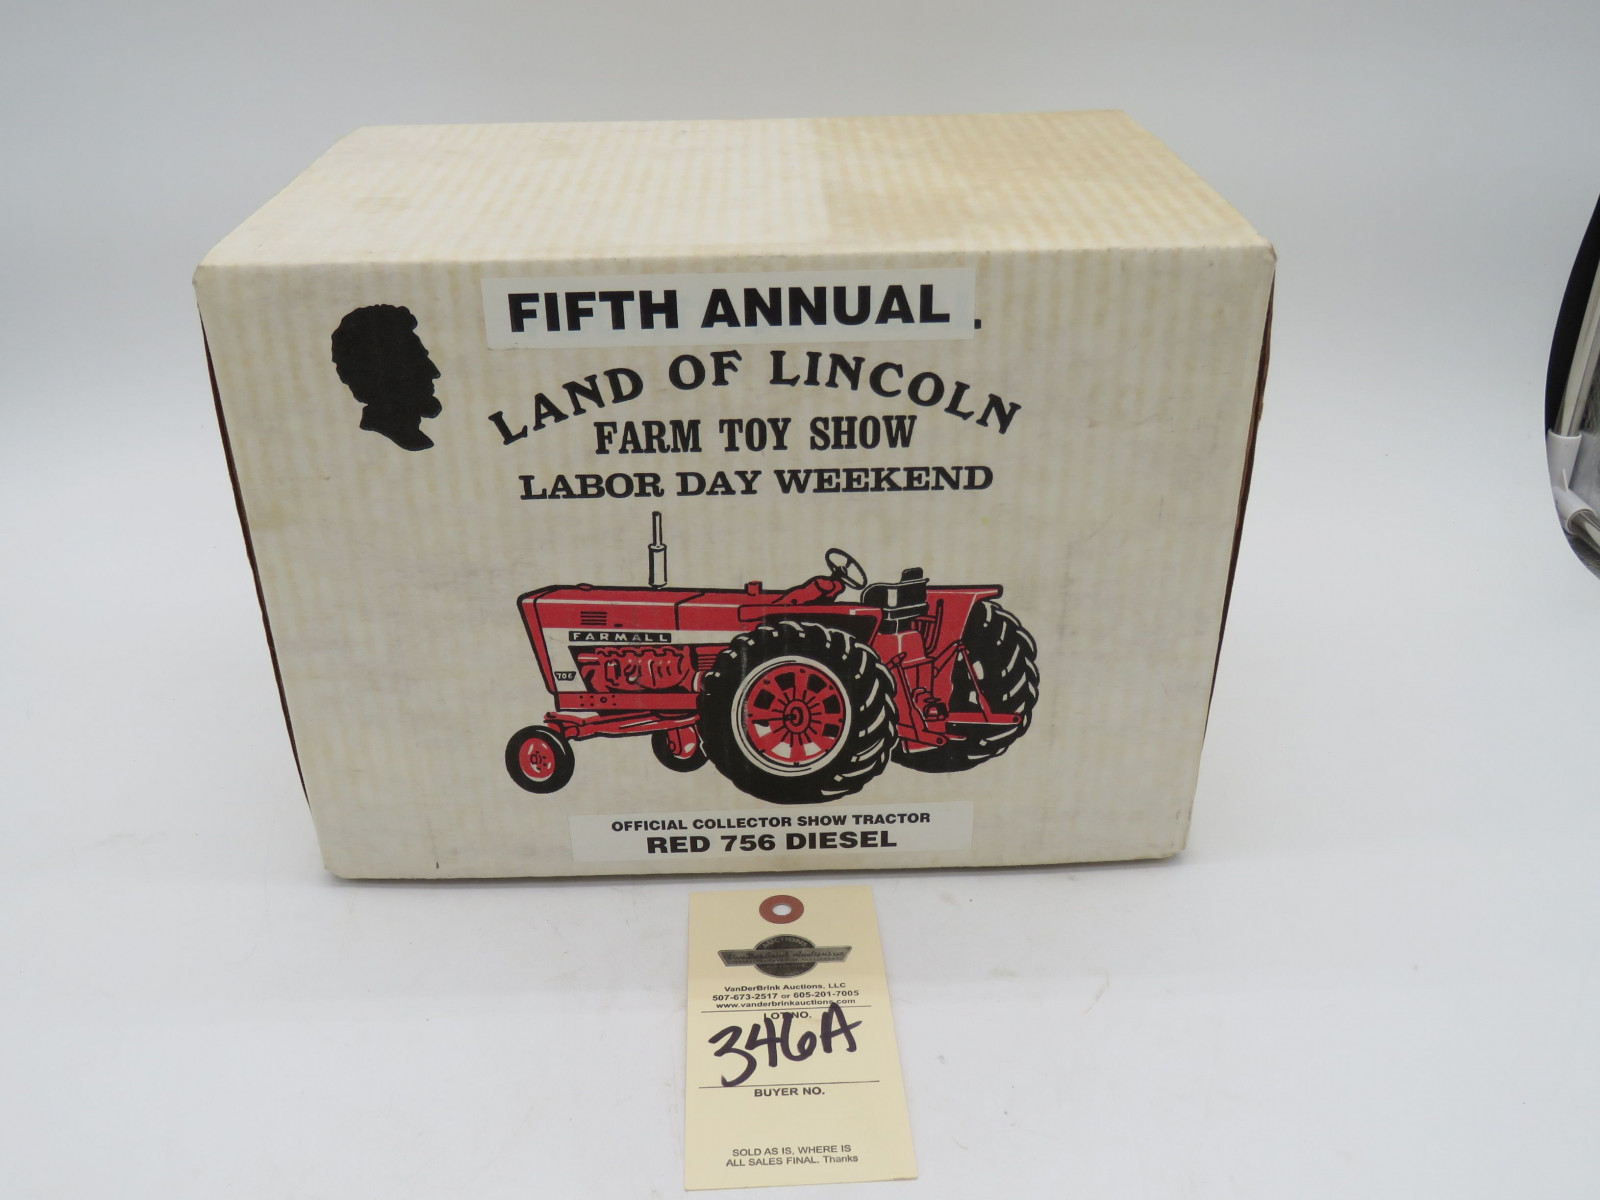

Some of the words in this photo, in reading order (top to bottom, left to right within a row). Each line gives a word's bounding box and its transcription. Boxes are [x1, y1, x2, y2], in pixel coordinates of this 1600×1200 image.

[508, 290, 678, 332] FIFTH
[701, 285, 950, 328] ANNUAL
[488, 367, 644, 446] LAND
[669, 350, 742, 390] OF
[769, 350, 1021, 435] LINCOLN
[594, 420, 702, 454] FARM
[719, 418, 791, 452] TOY
[810, 415, 917, 450] SHOW
[519, 473, 664, 500] LABOR
[676, 470, 761, 496] DAY
[774, 466, 993, 493] WEEKEND
[573, 633, 669, 642] FARMALL
[611, 819, 688, 832] OFFICIAL
[692, 816, 792, 830] COLLECTOR
[797, 814, 847, 827] SHOW
[851, 812, 931, 825] TRACTOR
[647, 836, 710, 853] RED
[721, 834, 775, 851] 756
[786, 831, 897, 849] DIESEL
[724, 984, 780, 992] VanDerBrink
[712, 992, 778, 1002] 507-673-2517
[793, 990, 859, 999] 605-201-7005
[714, 999, 857, 1009] www.vanderbrinkauctionscom
[791, 1011, 812, 1020] NO.
[708, 1002, 862, 1087] 346A
[754, 1087, 799, 1098] BUYER
[802, 1086, 825, 1096] NO.
[732, 1148, 762, 1157] SOLD
[763, 1147, 779, 1156] AS
[781, 1146, 795, 1156] IS,
[797, 1145, 838, 1154] WHERE
[840, 1144, 852, 1153] IS
[725, 1158, 746, 1167] ALL
[748, 1157, 783, 1167] SALES
[786, 1156, 820, 1165] FINAL.
[822, 1154, 859, 1164] Thanks
